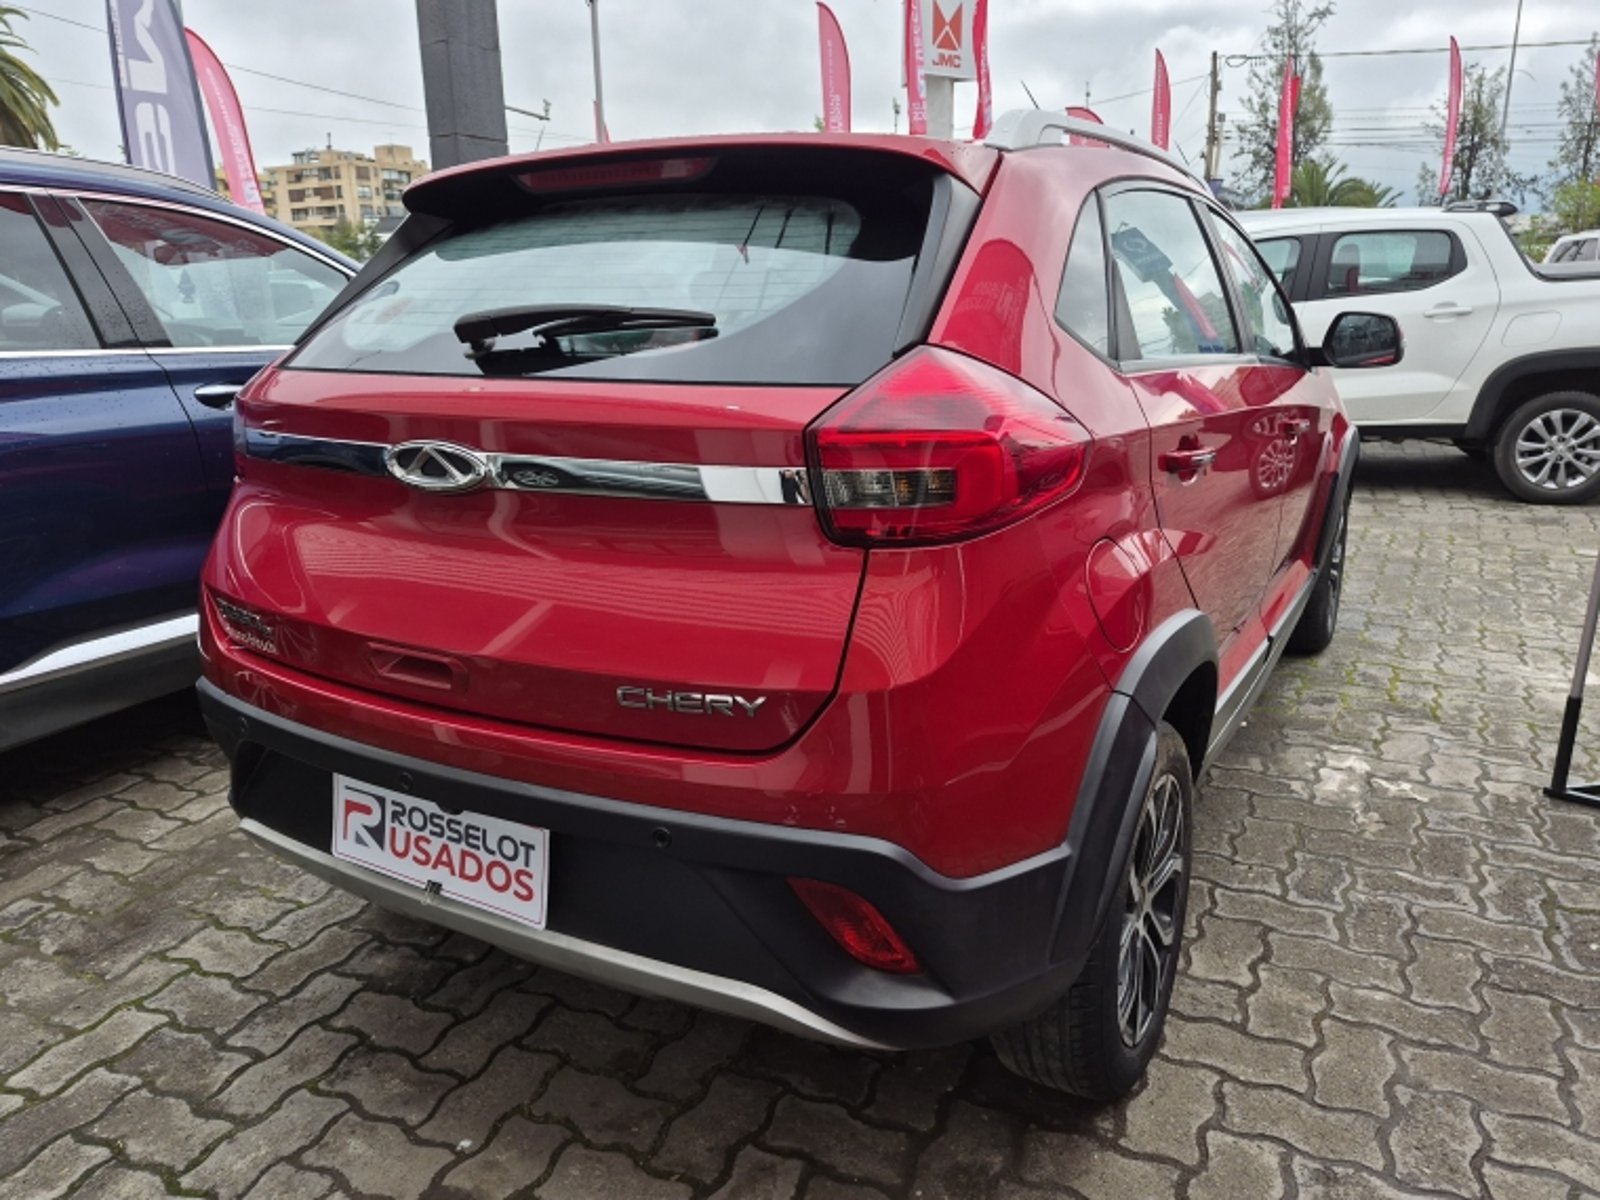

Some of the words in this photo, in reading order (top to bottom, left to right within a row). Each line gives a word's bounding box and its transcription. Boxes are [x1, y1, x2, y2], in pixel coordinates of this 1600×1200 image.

[932, 52, 962, 68] JMC
[616, 685, 767, 718] CHERY
[390, 798, 535, 868] ROSSELOT
[389, 826, 535, 902] USADOS
